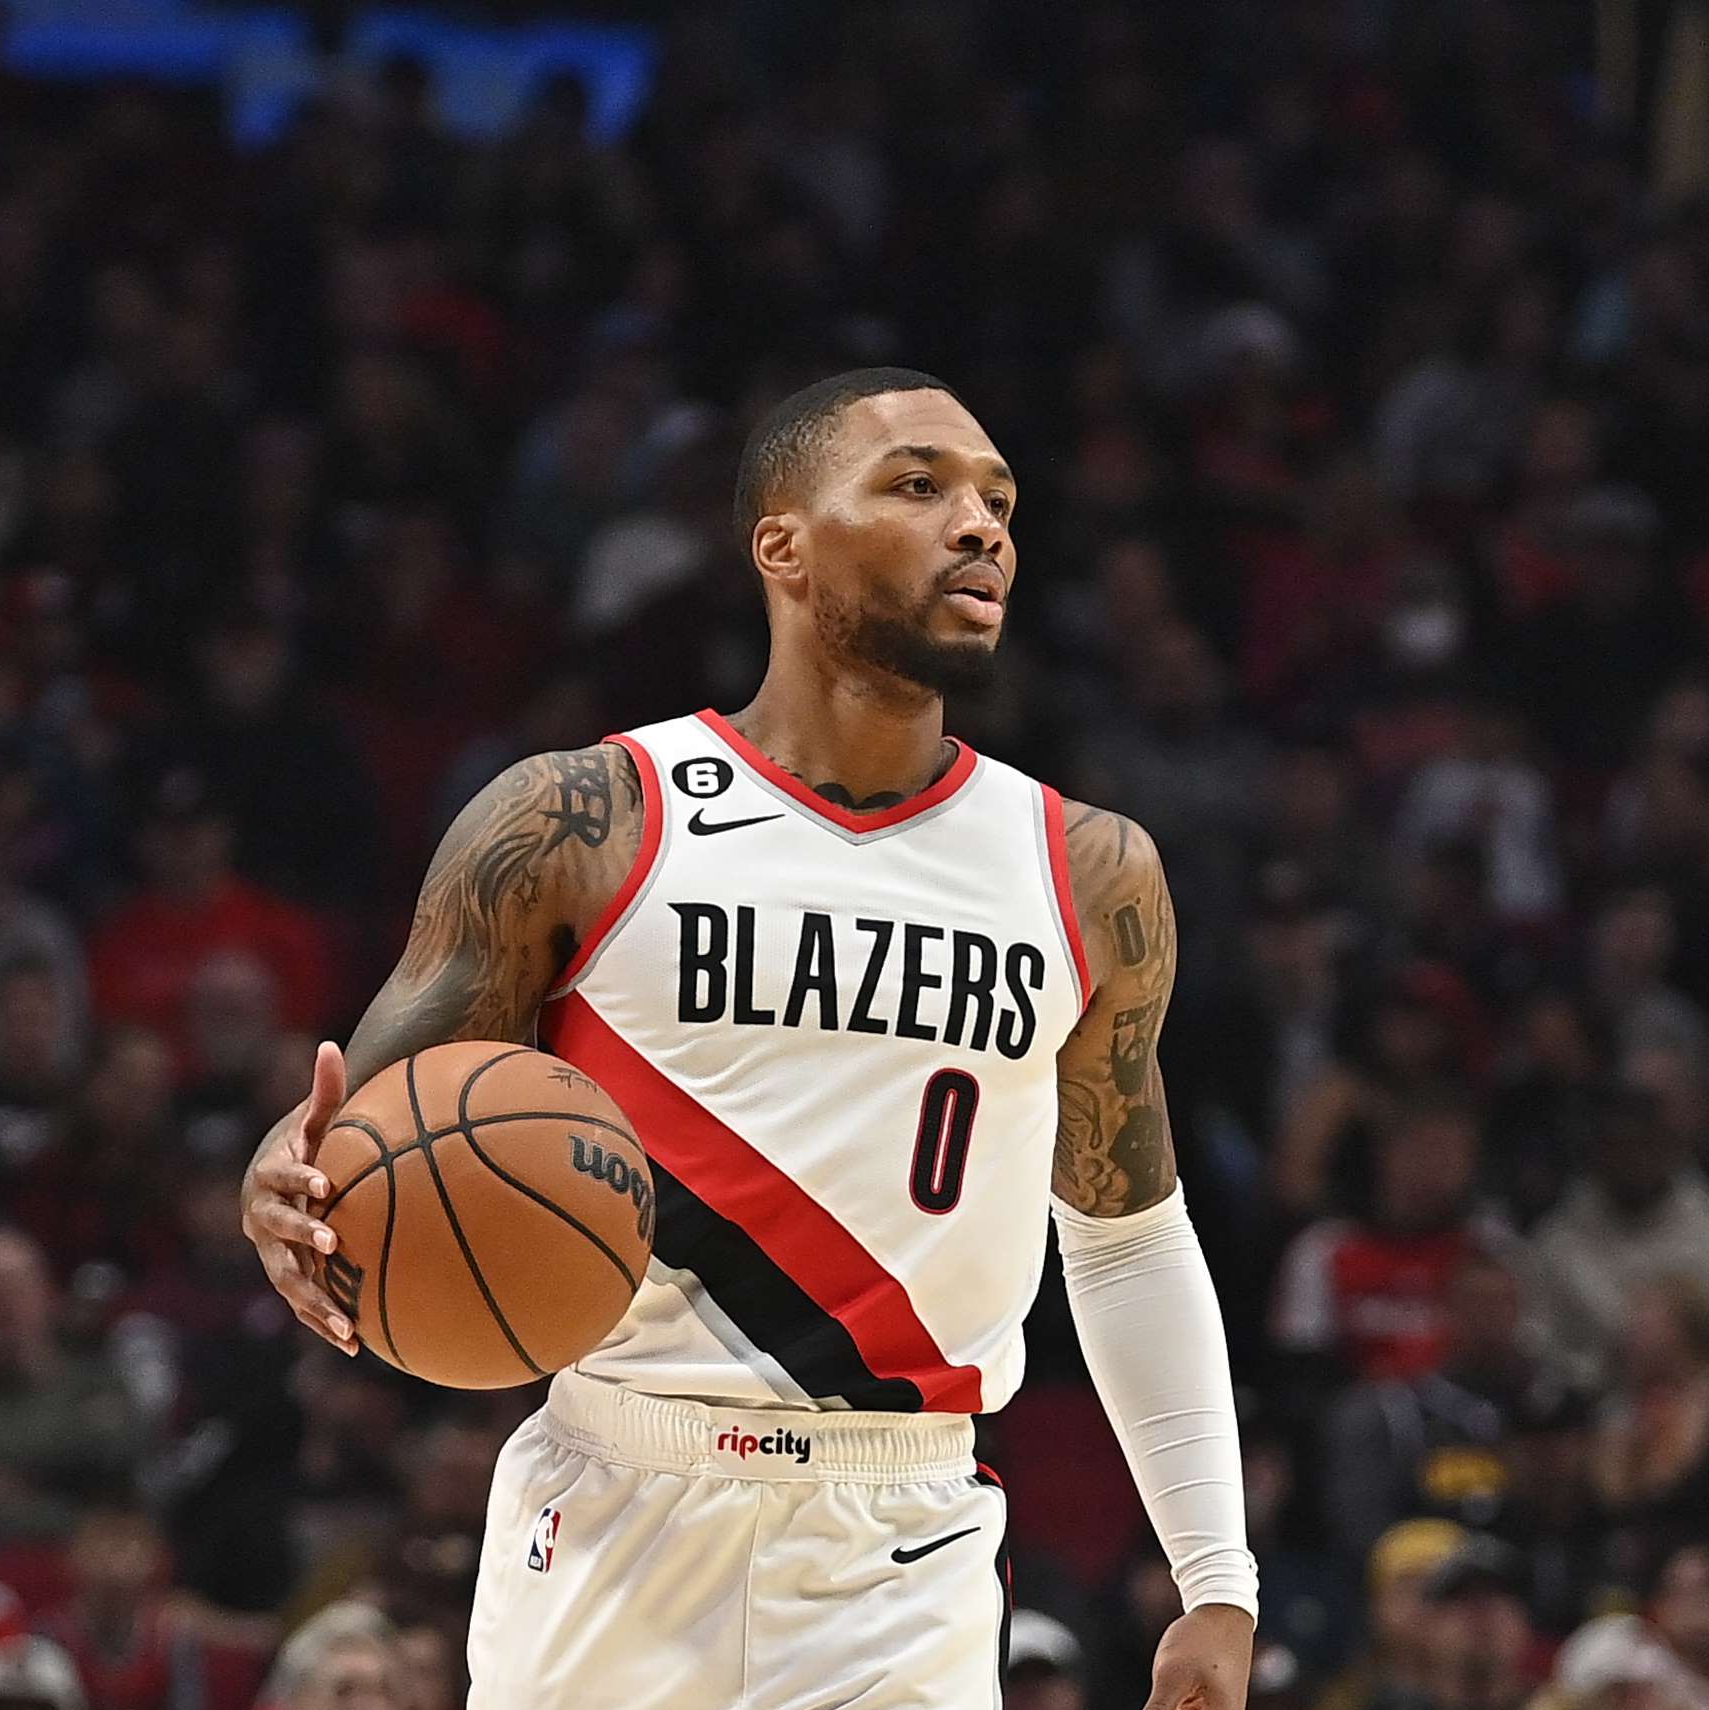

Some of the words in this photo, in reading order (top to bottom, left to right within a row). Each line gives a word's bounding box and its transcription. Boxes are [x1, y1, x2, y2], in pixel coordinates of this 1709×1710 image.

[686, 764, 720, 795] 6
[667, 902, 1046, 1061] BLAZERS
[908, 1067, 981, 1216] 0
[716, 1425, 812, 1464] ripcity
